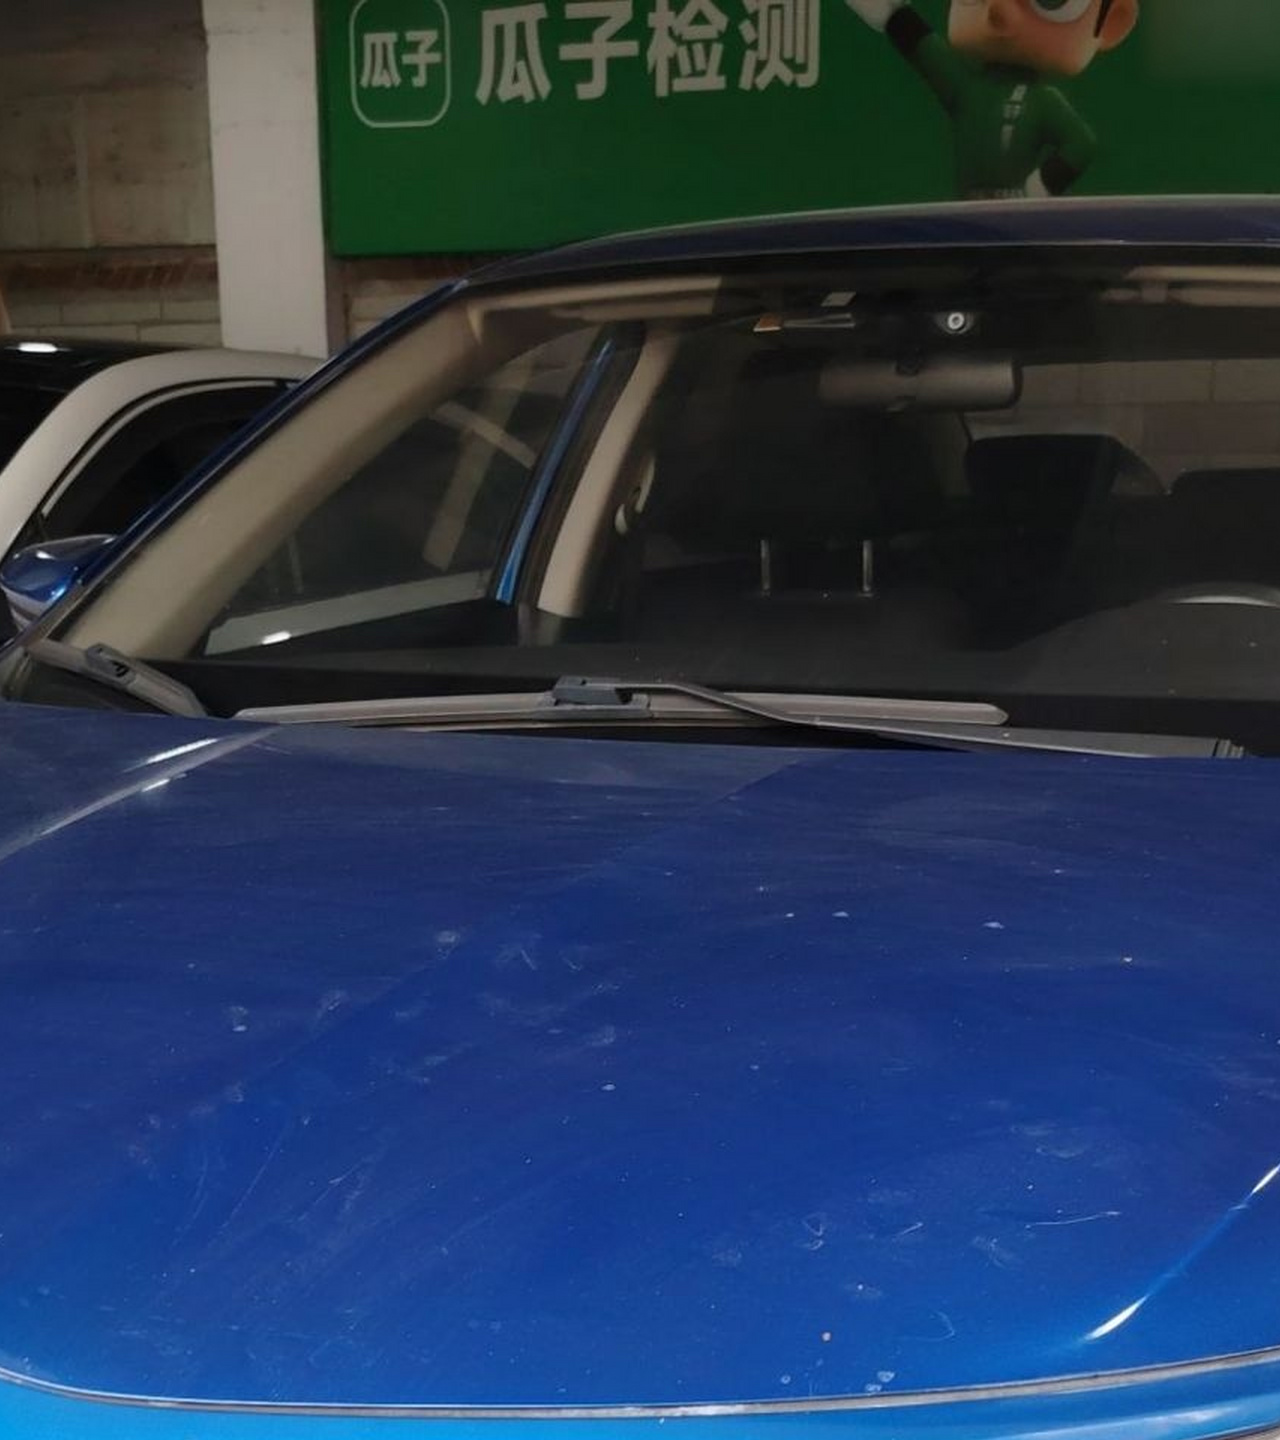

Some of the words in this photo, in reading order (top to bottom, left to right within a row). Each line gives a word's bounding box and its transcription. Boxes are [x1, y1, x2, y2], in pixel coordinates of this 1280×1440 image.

[359, 29, 443, 88] 瓜子
[475, 0, 821, 106] 瓜子检测
